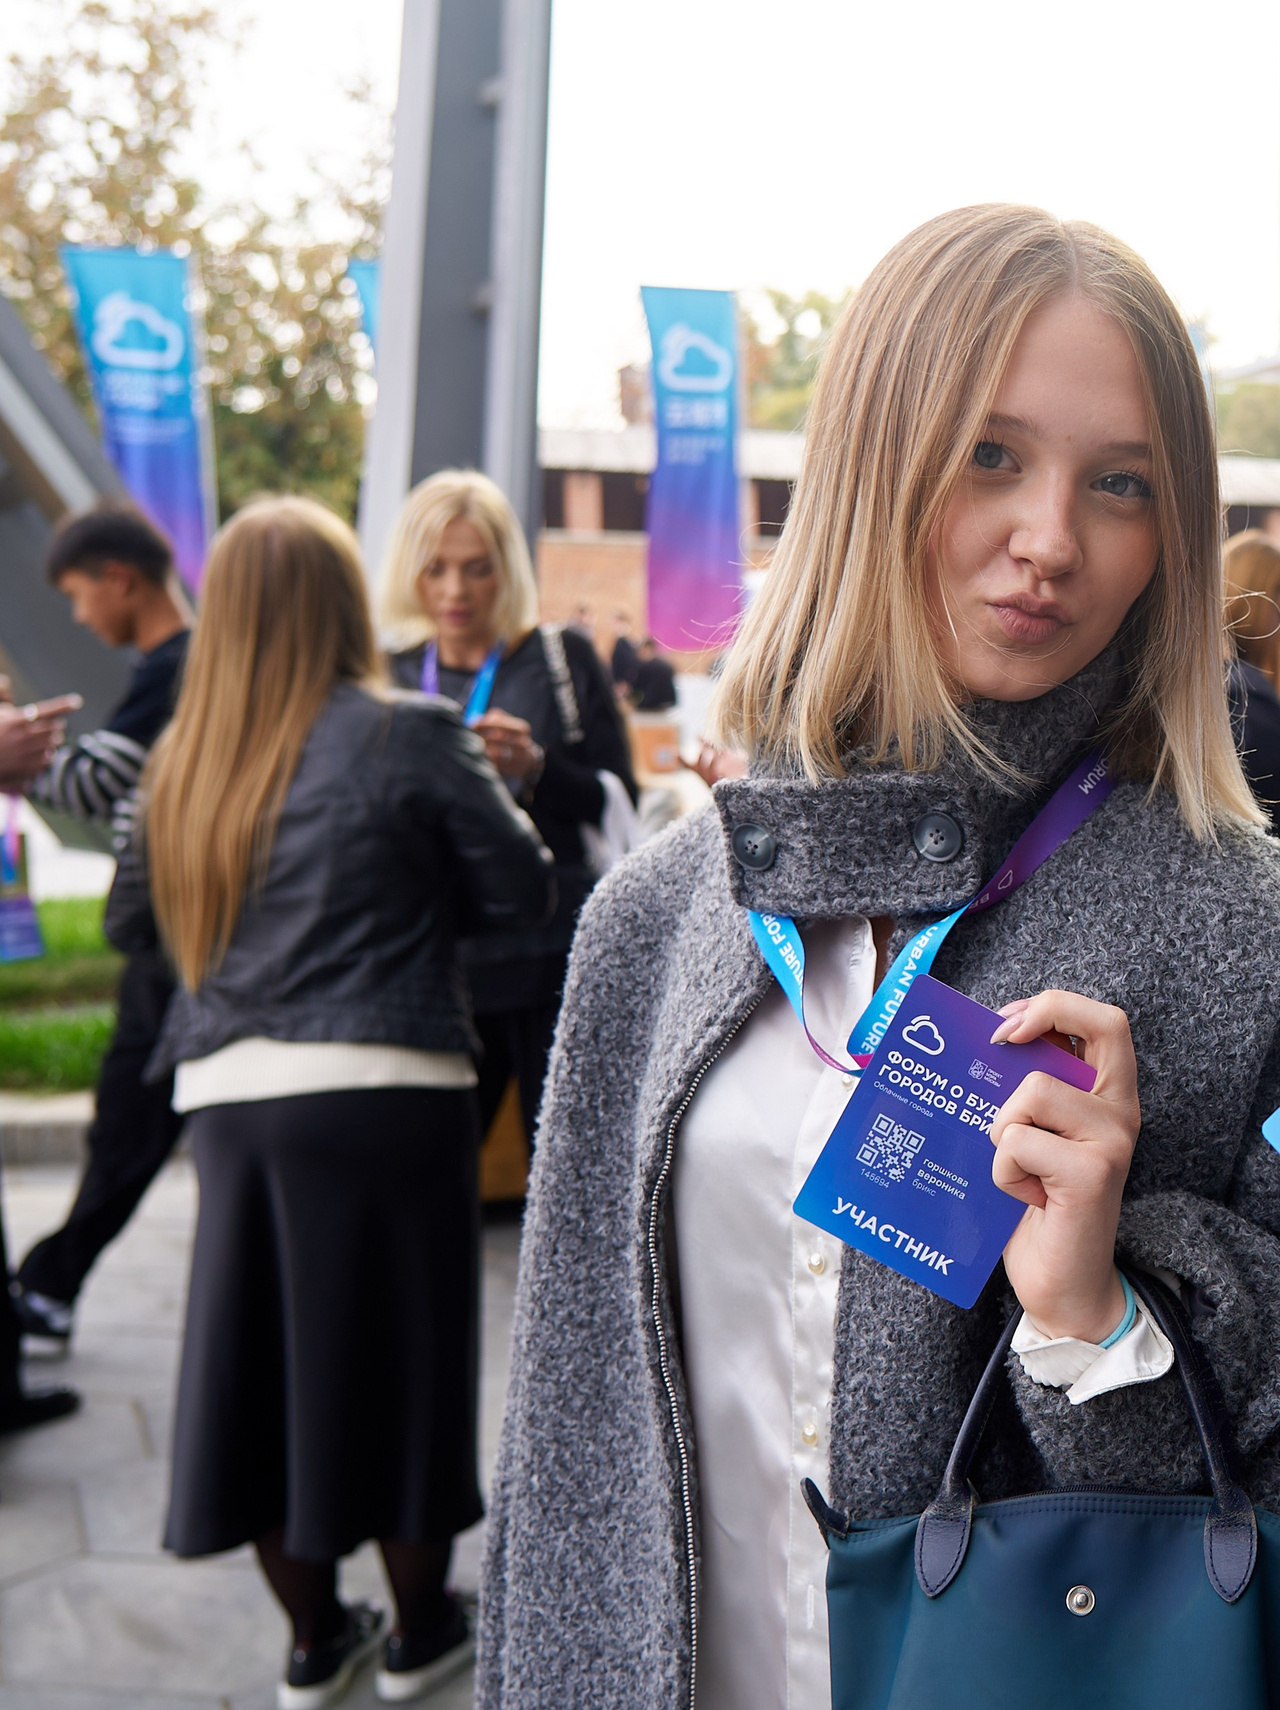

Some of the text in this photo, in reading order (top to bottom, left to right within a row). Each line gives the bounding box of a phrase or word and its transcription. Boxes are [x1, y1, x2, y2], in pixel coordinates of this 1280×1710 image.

[1078, 758, 1111, 795] ORUM
[760, 913, 804, 993] TURE FOR
[861, 925, 939, 1054] URBAN FUTURE
[873, 1080, 934, 1118] Облачные города
[878, 1064, 994, 1135] ГОРОДОВ БРИ
[887, 1050, 1001, 1119] ФОРУМ О БУД
[911, 1178, 937, 1197] брикс
[917, 1169, 966, 1200] вероника
[922, 1158, 969, 1188] горшкова
[831, 1196, 954, 1276] УЧАСТНИК
